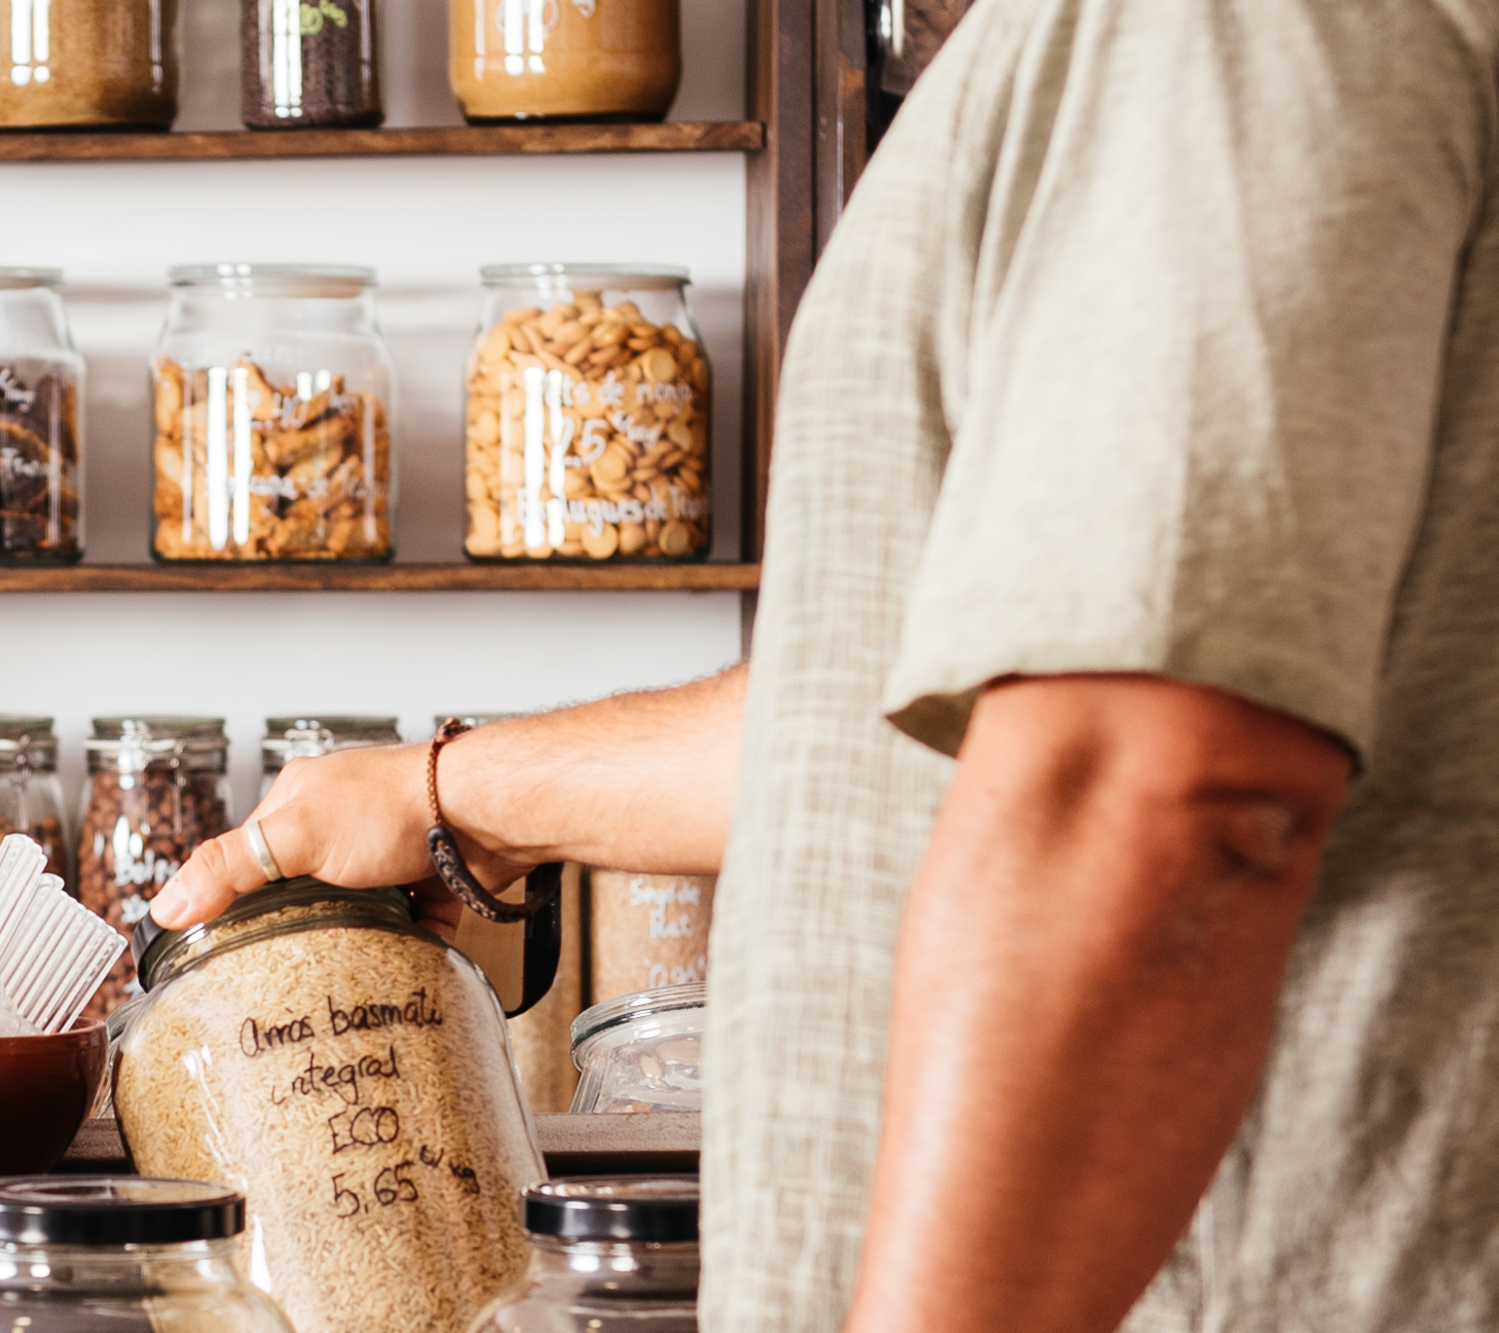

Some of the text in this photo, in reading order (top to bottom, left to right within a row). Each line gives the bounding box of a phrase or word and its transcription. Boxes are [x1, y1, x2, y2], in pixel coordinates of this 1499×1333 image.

[239, 1015, 317, 1058] Arròs
[271, 1046, 402, 1106] integral
[330, 1106, 401, 1155] ECO
